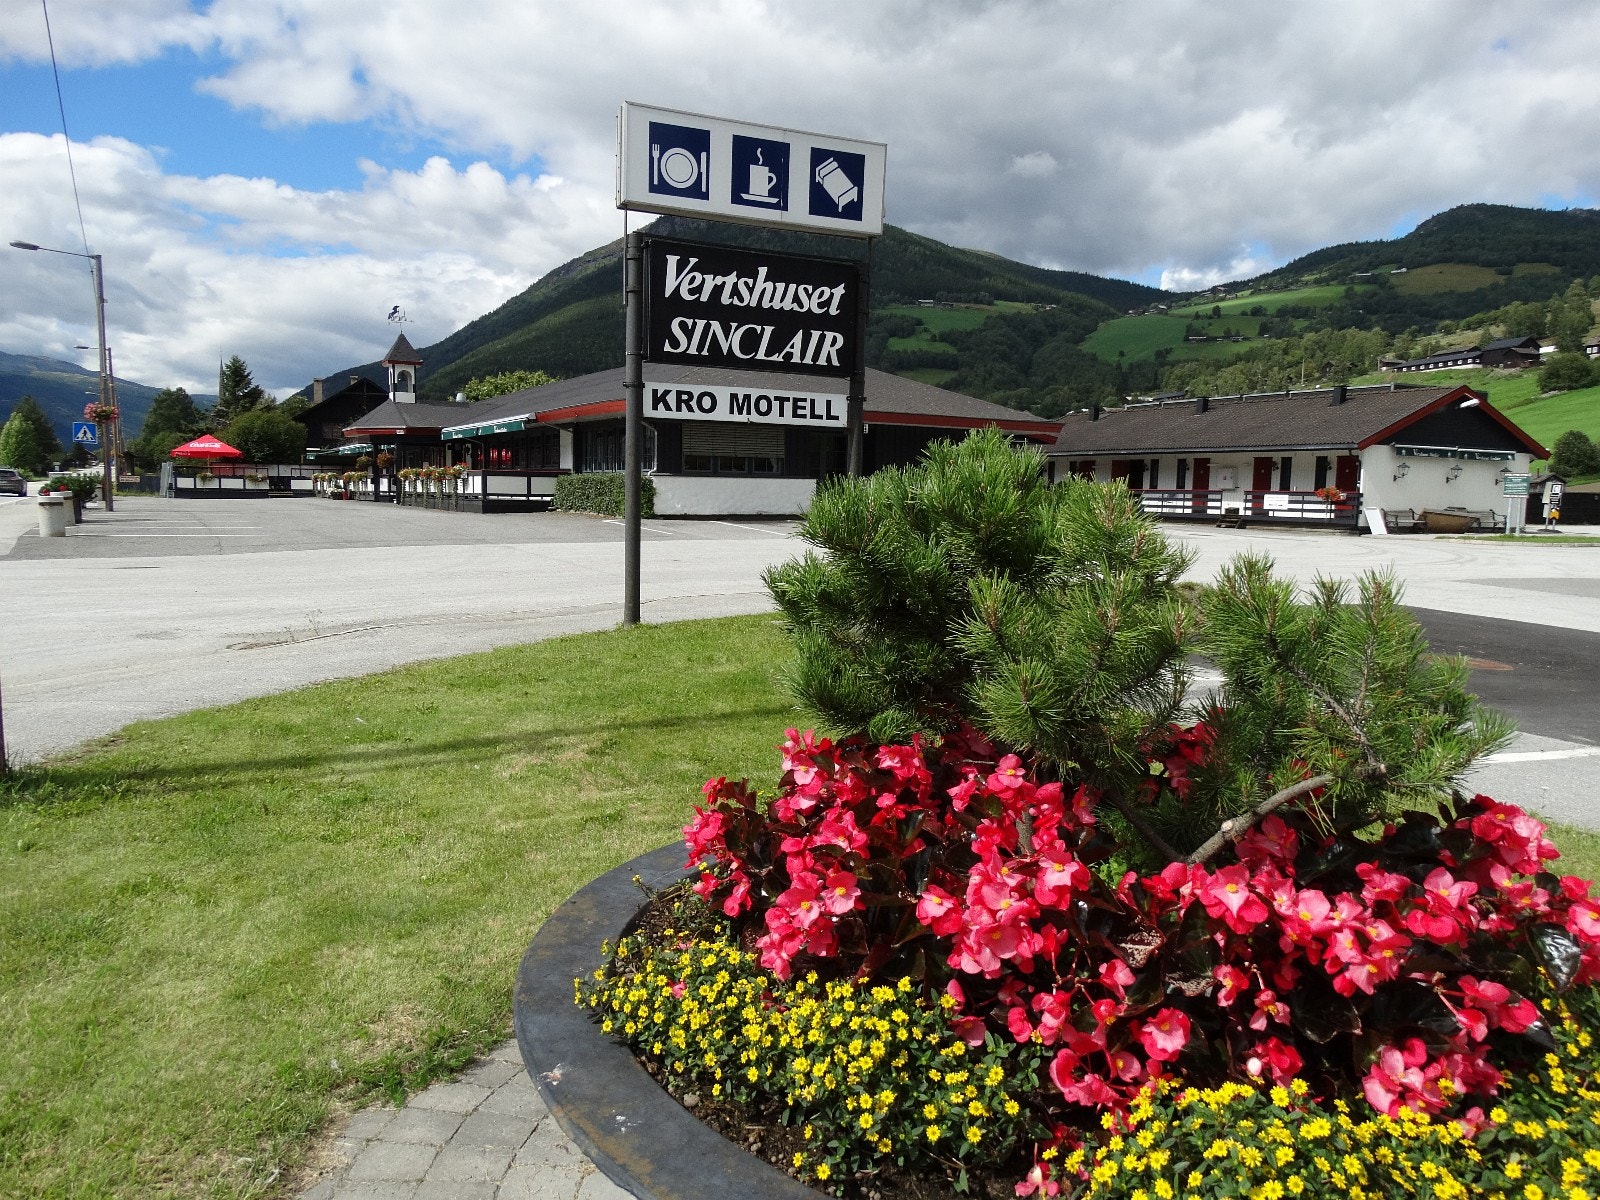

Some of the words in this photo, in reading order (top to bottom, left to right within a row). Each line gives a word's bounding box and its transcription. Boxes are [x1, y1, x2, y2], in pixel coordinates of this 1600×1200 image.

[664, 254, 845, 316] Vertshuset
[663, 317, 844, 367] SINCLAIR
[651, 388, 717, 415] KRO
[729, 392, 839, 421] MOTELL
